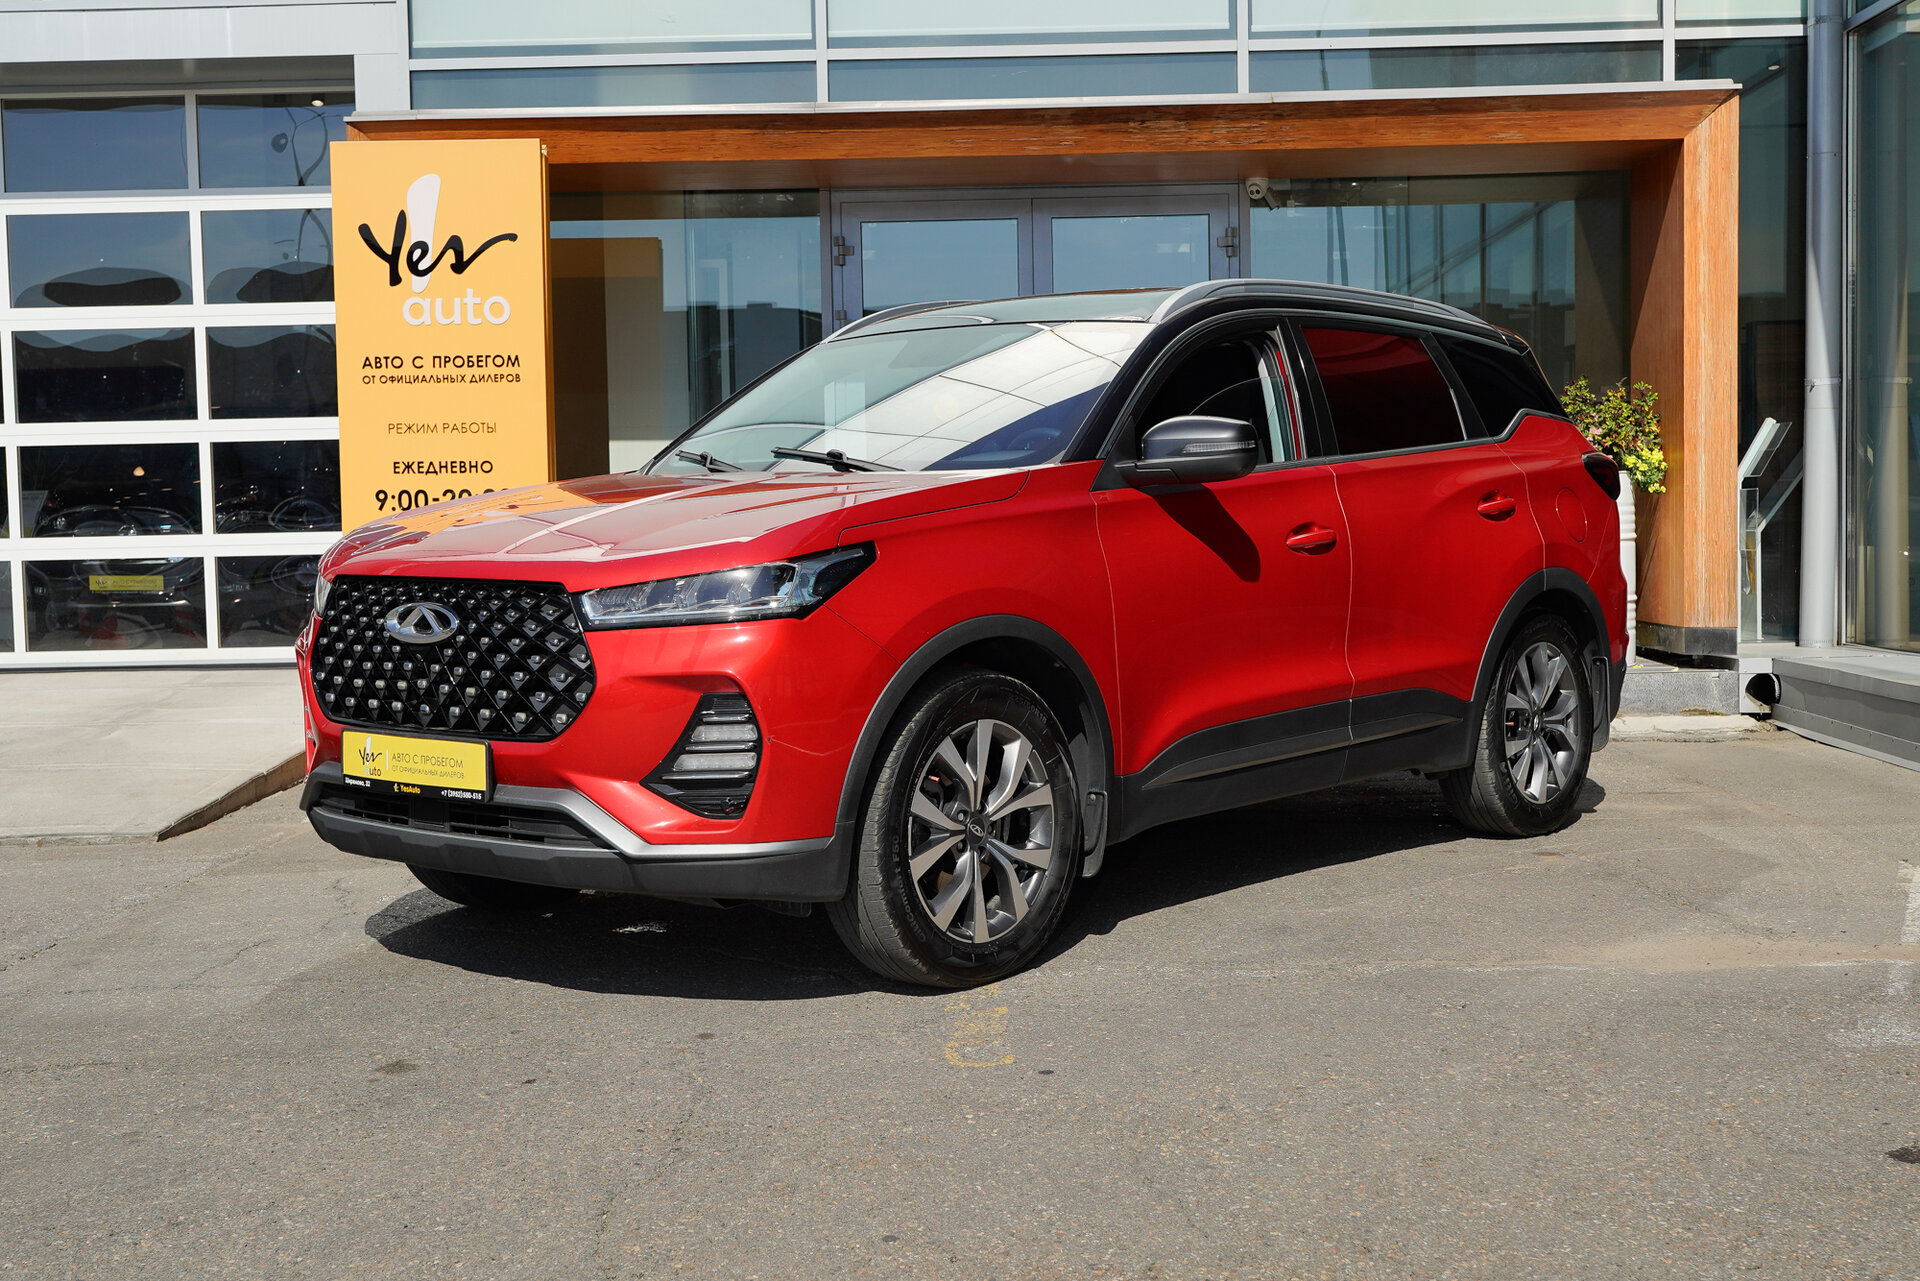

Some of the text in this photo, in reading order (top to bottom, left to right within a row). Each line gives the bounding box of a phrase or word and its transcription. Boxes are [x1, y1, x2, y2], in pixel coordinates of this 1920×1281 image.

[402, 288, 511, 326] auto
[362, 354, 521, 369] АВТО С ПРОБЕГОМ
[362, 373, 521, 385] ОТ ОФИЦИАЛЬНЫХ ДИЛЕРОВ
[388, 422, 497, 434] РЕЖИМ РАБОТЫ
[393, 460, 494, 476] ЕЖЕДНЕВНО
[392, 753, 464, 768] АВТО С ПРОБЕГОМ
